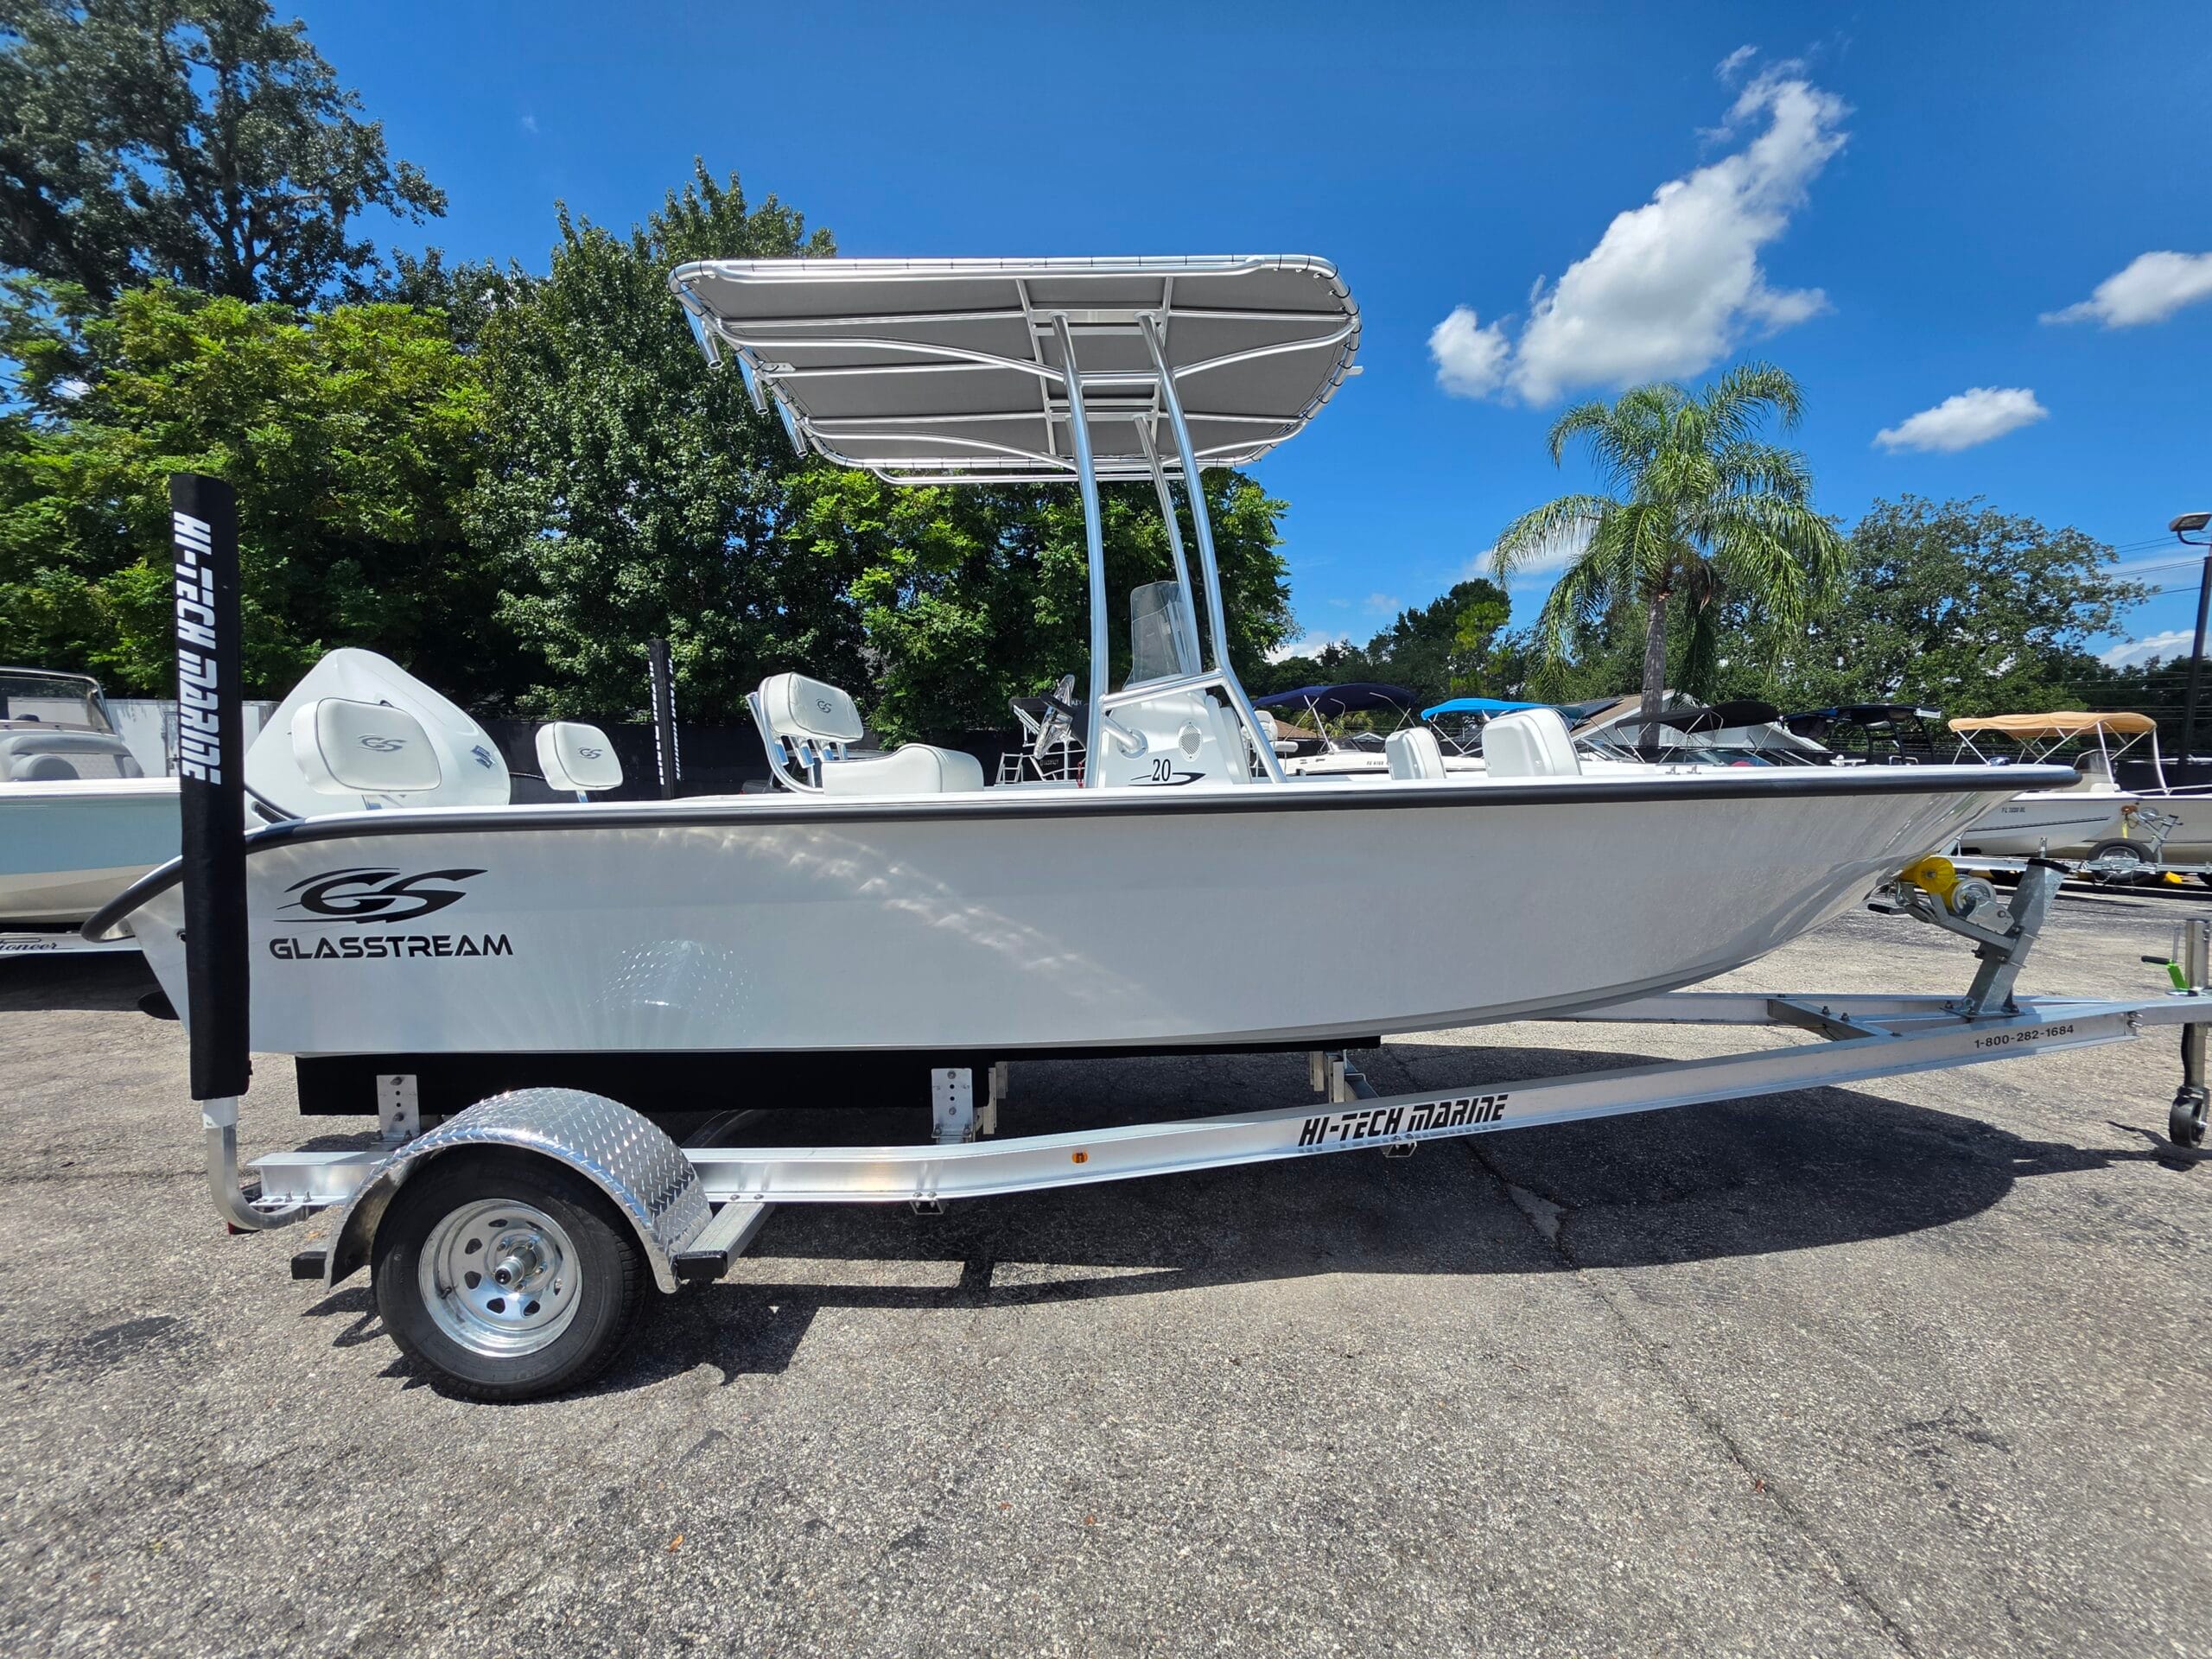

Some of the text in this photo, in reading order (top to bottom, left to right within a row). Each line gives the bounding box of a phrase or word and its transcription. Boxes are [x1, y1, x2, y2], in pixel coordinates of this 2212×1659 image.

[174, 511, 221, 785] HI-TECH MARINE
[1152, 759, 1171, 781] 20
[269, 934, 513, 959] GLASSTREAM
[1974, 1024, 2074, 1048] 1-800-282-1684
[1298, 1094, 1509, 1147] HI-TECH MARINE
